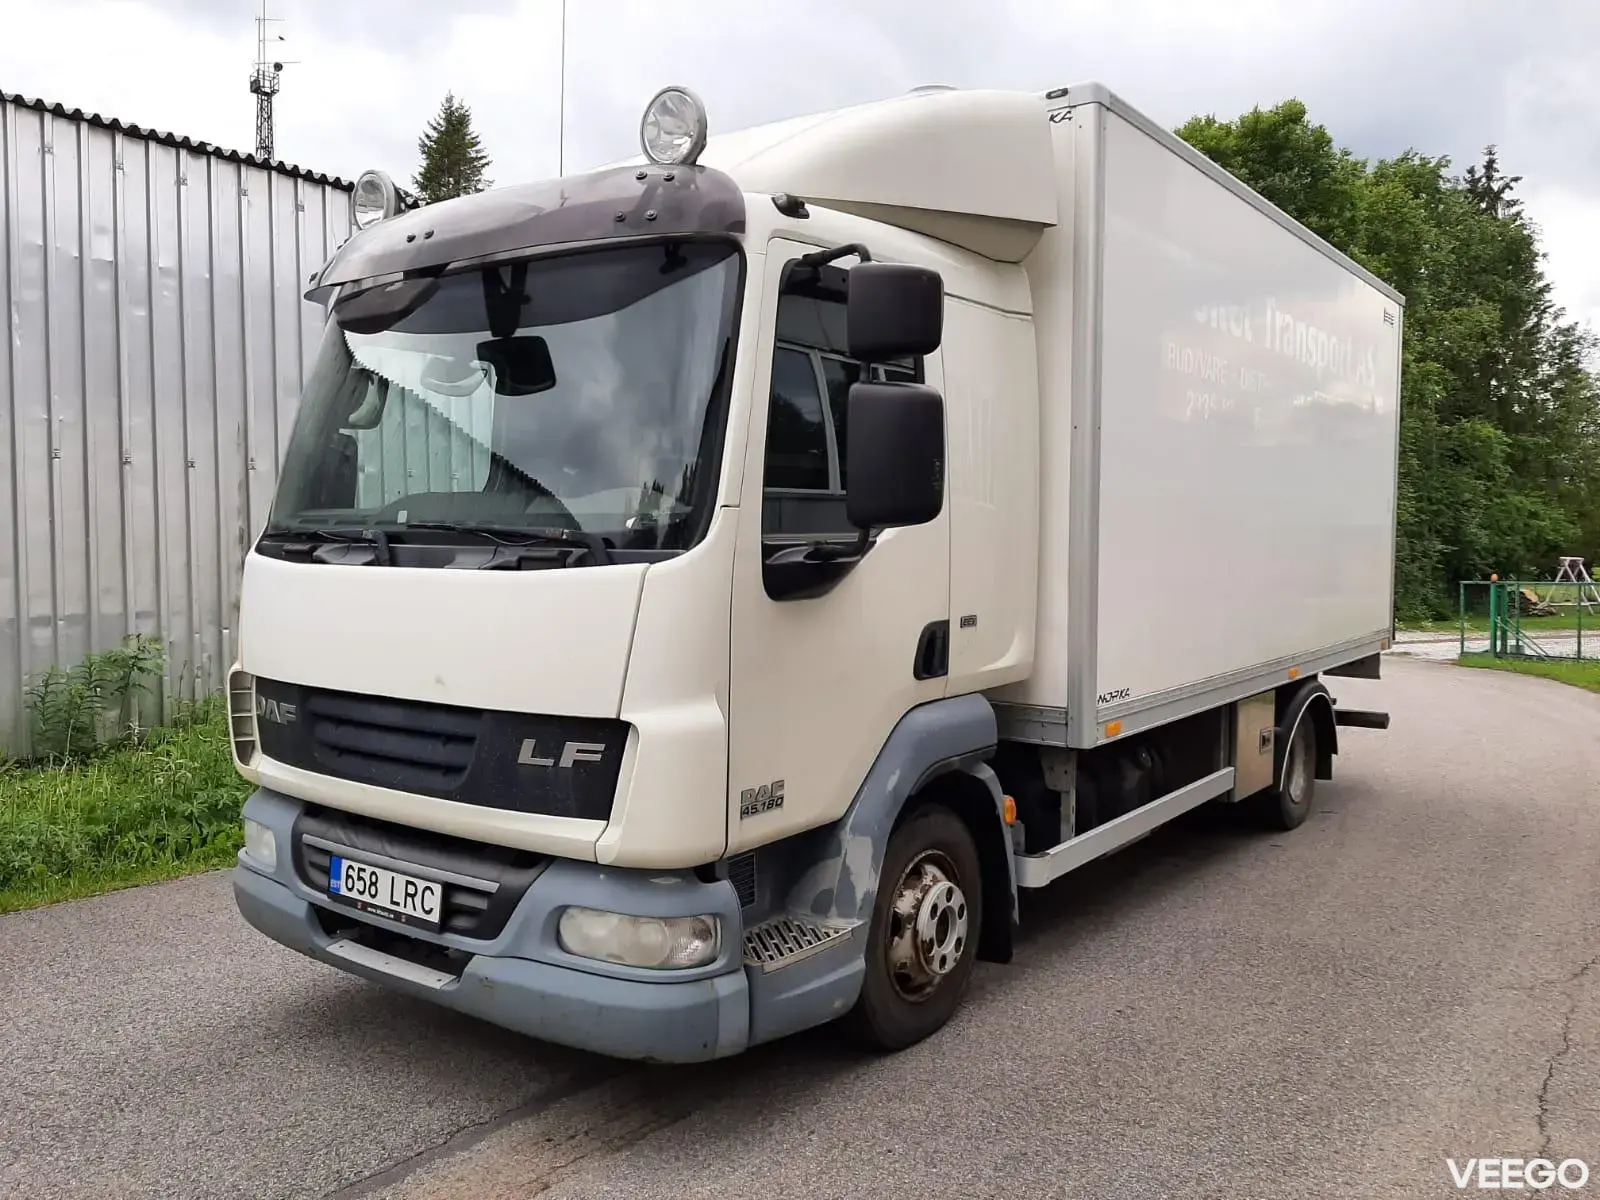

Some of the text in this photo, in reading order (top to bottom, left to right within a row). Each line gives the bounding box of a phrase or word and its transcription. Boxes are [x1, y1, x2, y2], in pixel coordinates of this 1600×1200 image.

[517, 738, 606, 767] LF
[741, 780, 784, 804] DAF
[345, 864, 435, 915] 658 LRC
